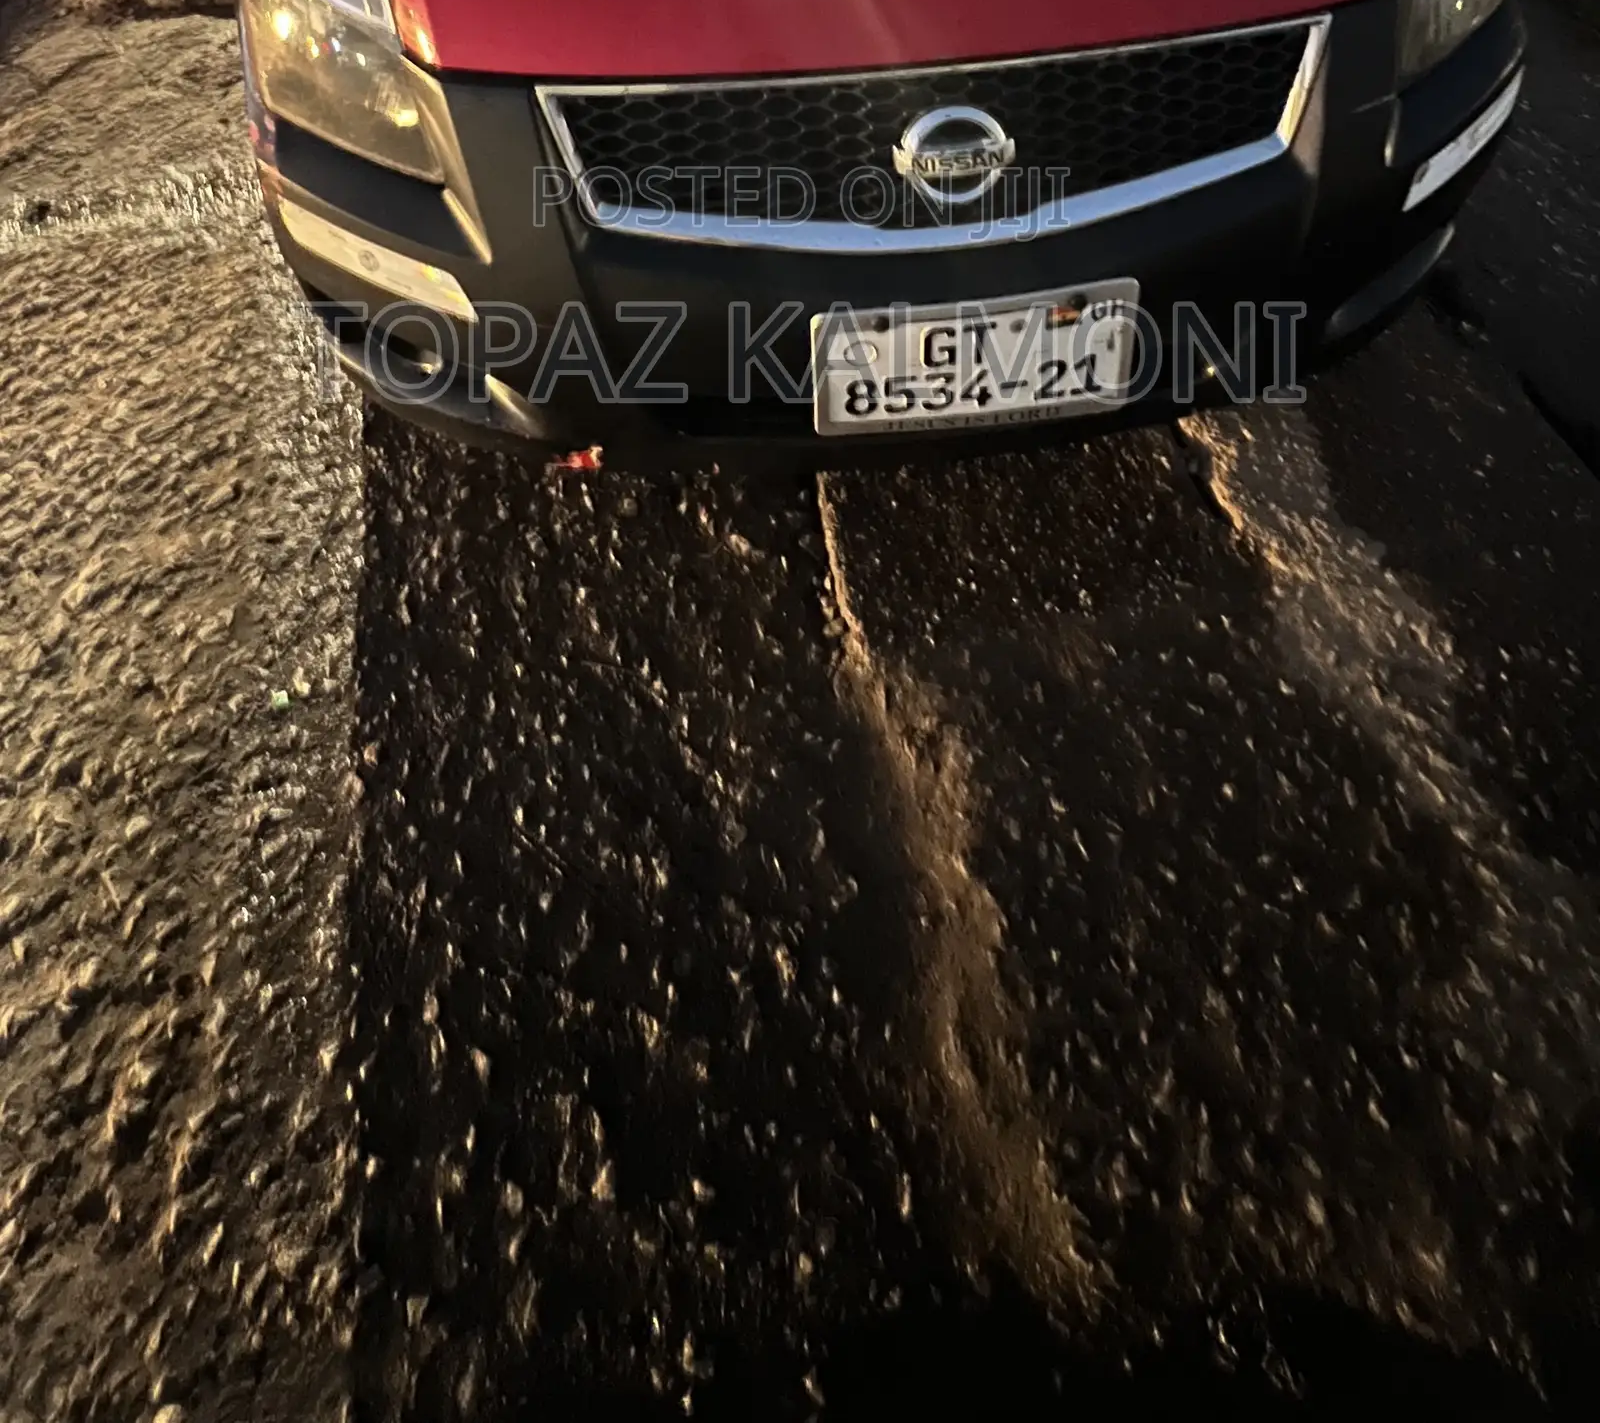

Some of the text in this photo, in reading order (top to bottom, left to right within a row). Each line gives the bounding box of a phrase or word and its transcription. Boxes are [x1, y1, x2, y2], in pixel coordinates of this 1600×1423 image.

[910, 148, 1005, 173] NISSAN
[922, 321, 997, 368] GT
[845, 353, 1103, 416] 8534-21
